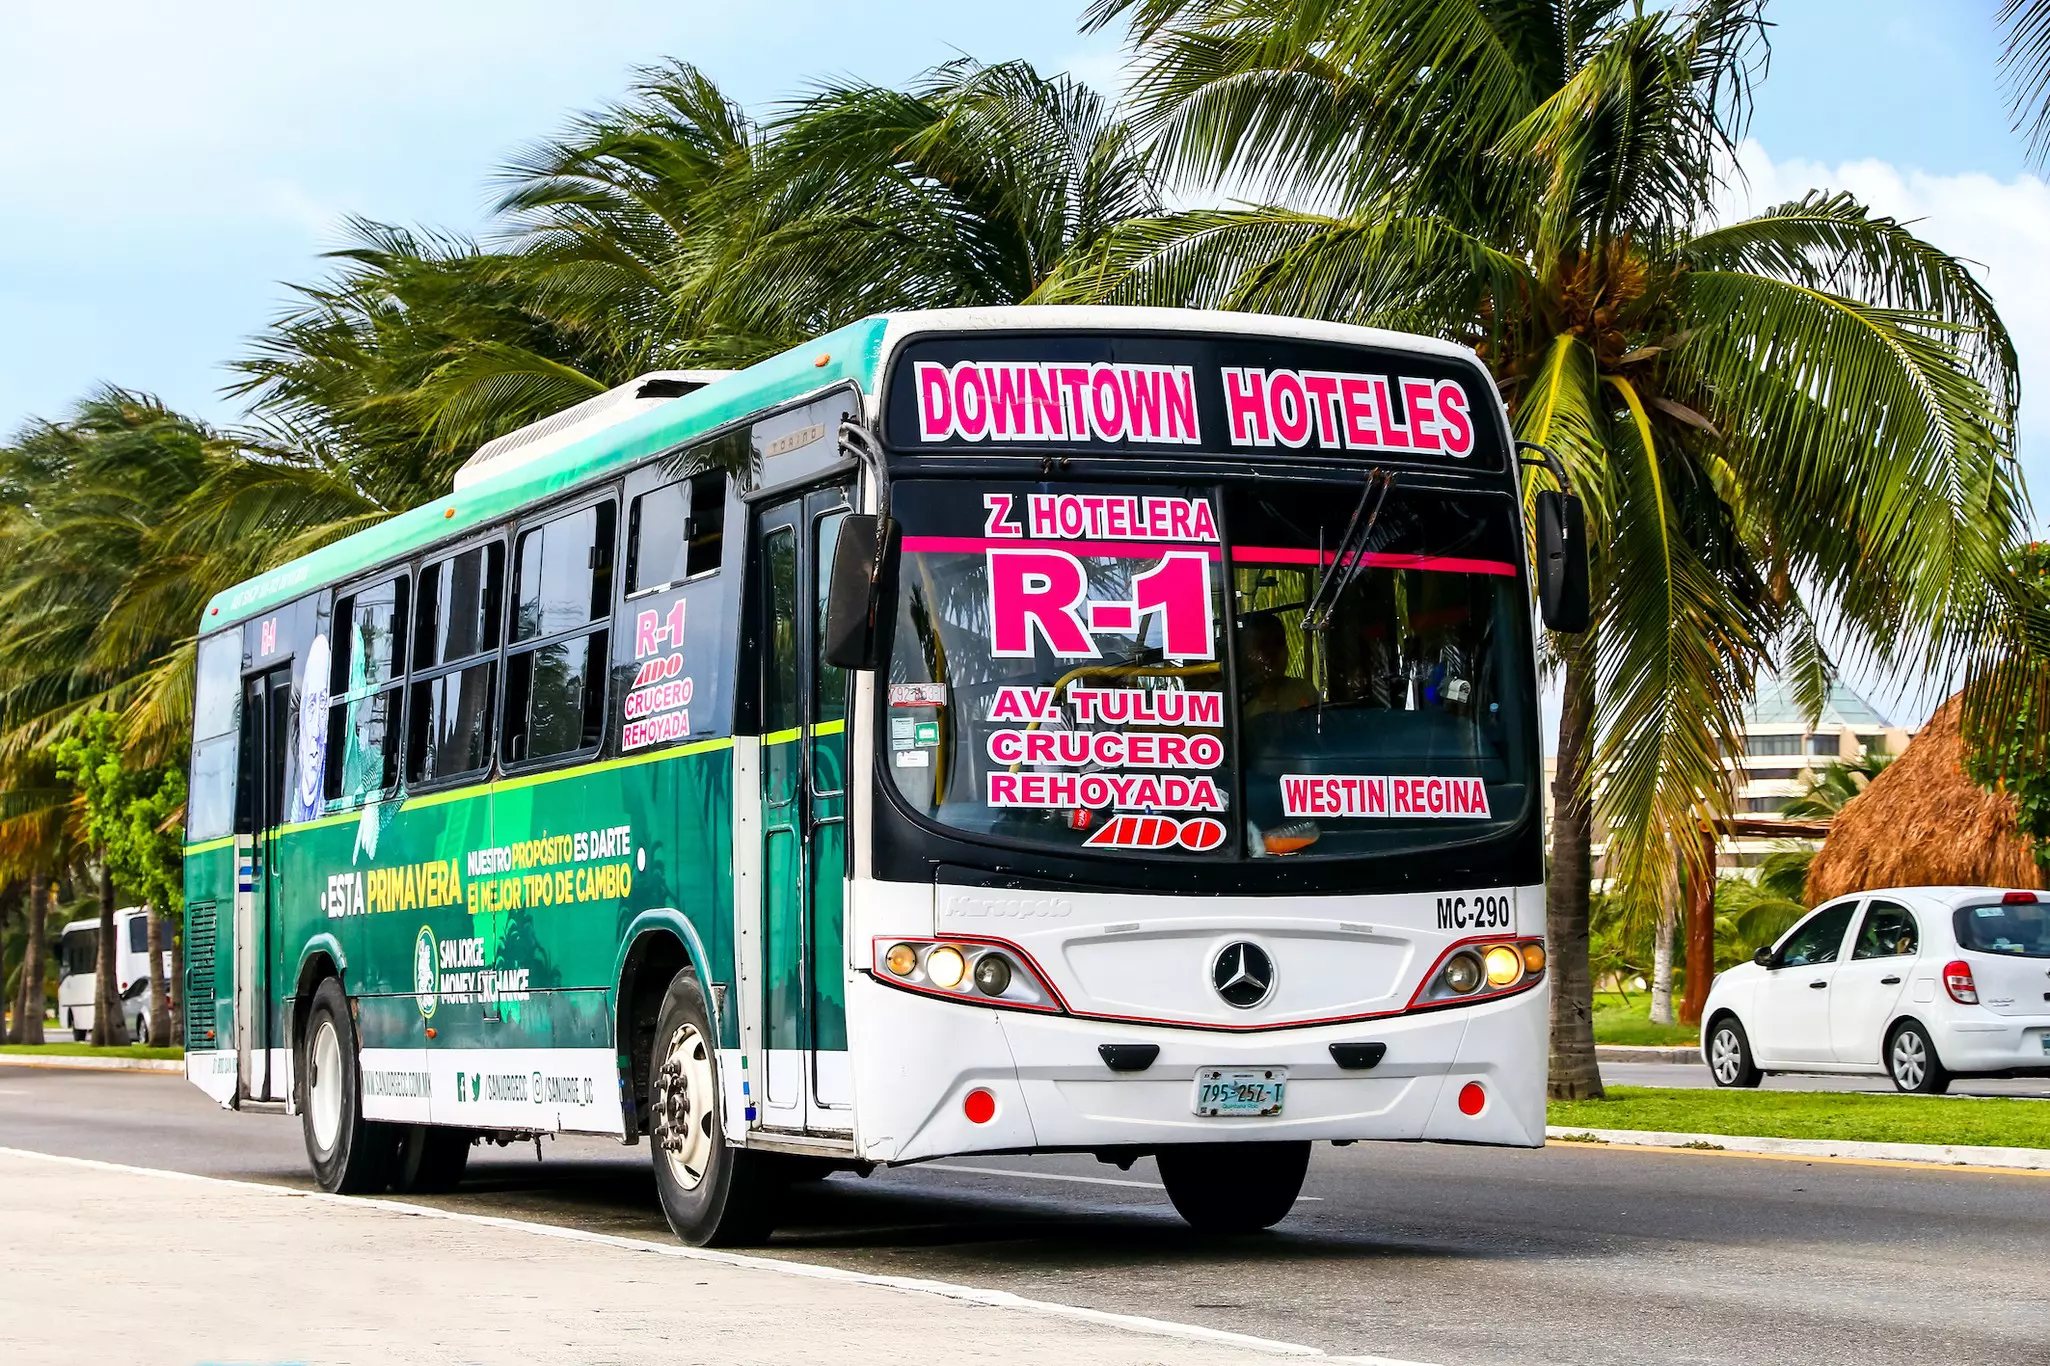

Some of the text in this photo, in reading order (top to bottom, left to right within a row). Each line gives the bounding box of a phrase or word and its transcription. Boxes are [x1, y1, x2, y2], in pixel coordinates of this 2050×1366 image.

[917, 364, 1472, 455] DOWNTOWN HOTELES
[772, 428, 817, 452] TORINO
[986, 495, 1218, 540] Z. HOTELERA
[989, 551, 1211, 657] R-1
[635, 599, 686, 658] R-1
[632, 654, 683, 688] ADO
[626, 679, 692, 719] CRUCERO
[990, 688, 1221, 725] AV. TULUM
[623, 711, 689, 750] REHOYADA
[989, 731, 1222, 767] CRUCERO
[989, 774, 1221, 809] REHOYADA
[1285, 778, 1487, 814] WESTIN REGINA
[468, 825, 631, 876] NUESTRO PROPÓSITO ES DARTE
[1086, 816, 1224, 850] ADO
[328, 858, 462, 918] ESTA PRIMAVERA
[481, 878, 522, 912] MEJOR
[523, 873, 553, 907] TIPO
[555, 870, 573, 904] DE
[576, 863, 632, 902] CAMBIO
[945, 896, 1072, 919] Marcopolo
[1437, 896, 1509, 928] MC-290
[440, 937, 485, 968] SAN JORGE
[440, 969, 530, 1004] MONEY EXCHANGE
[1203, 1084, 1282, 1102] 795-257-T
